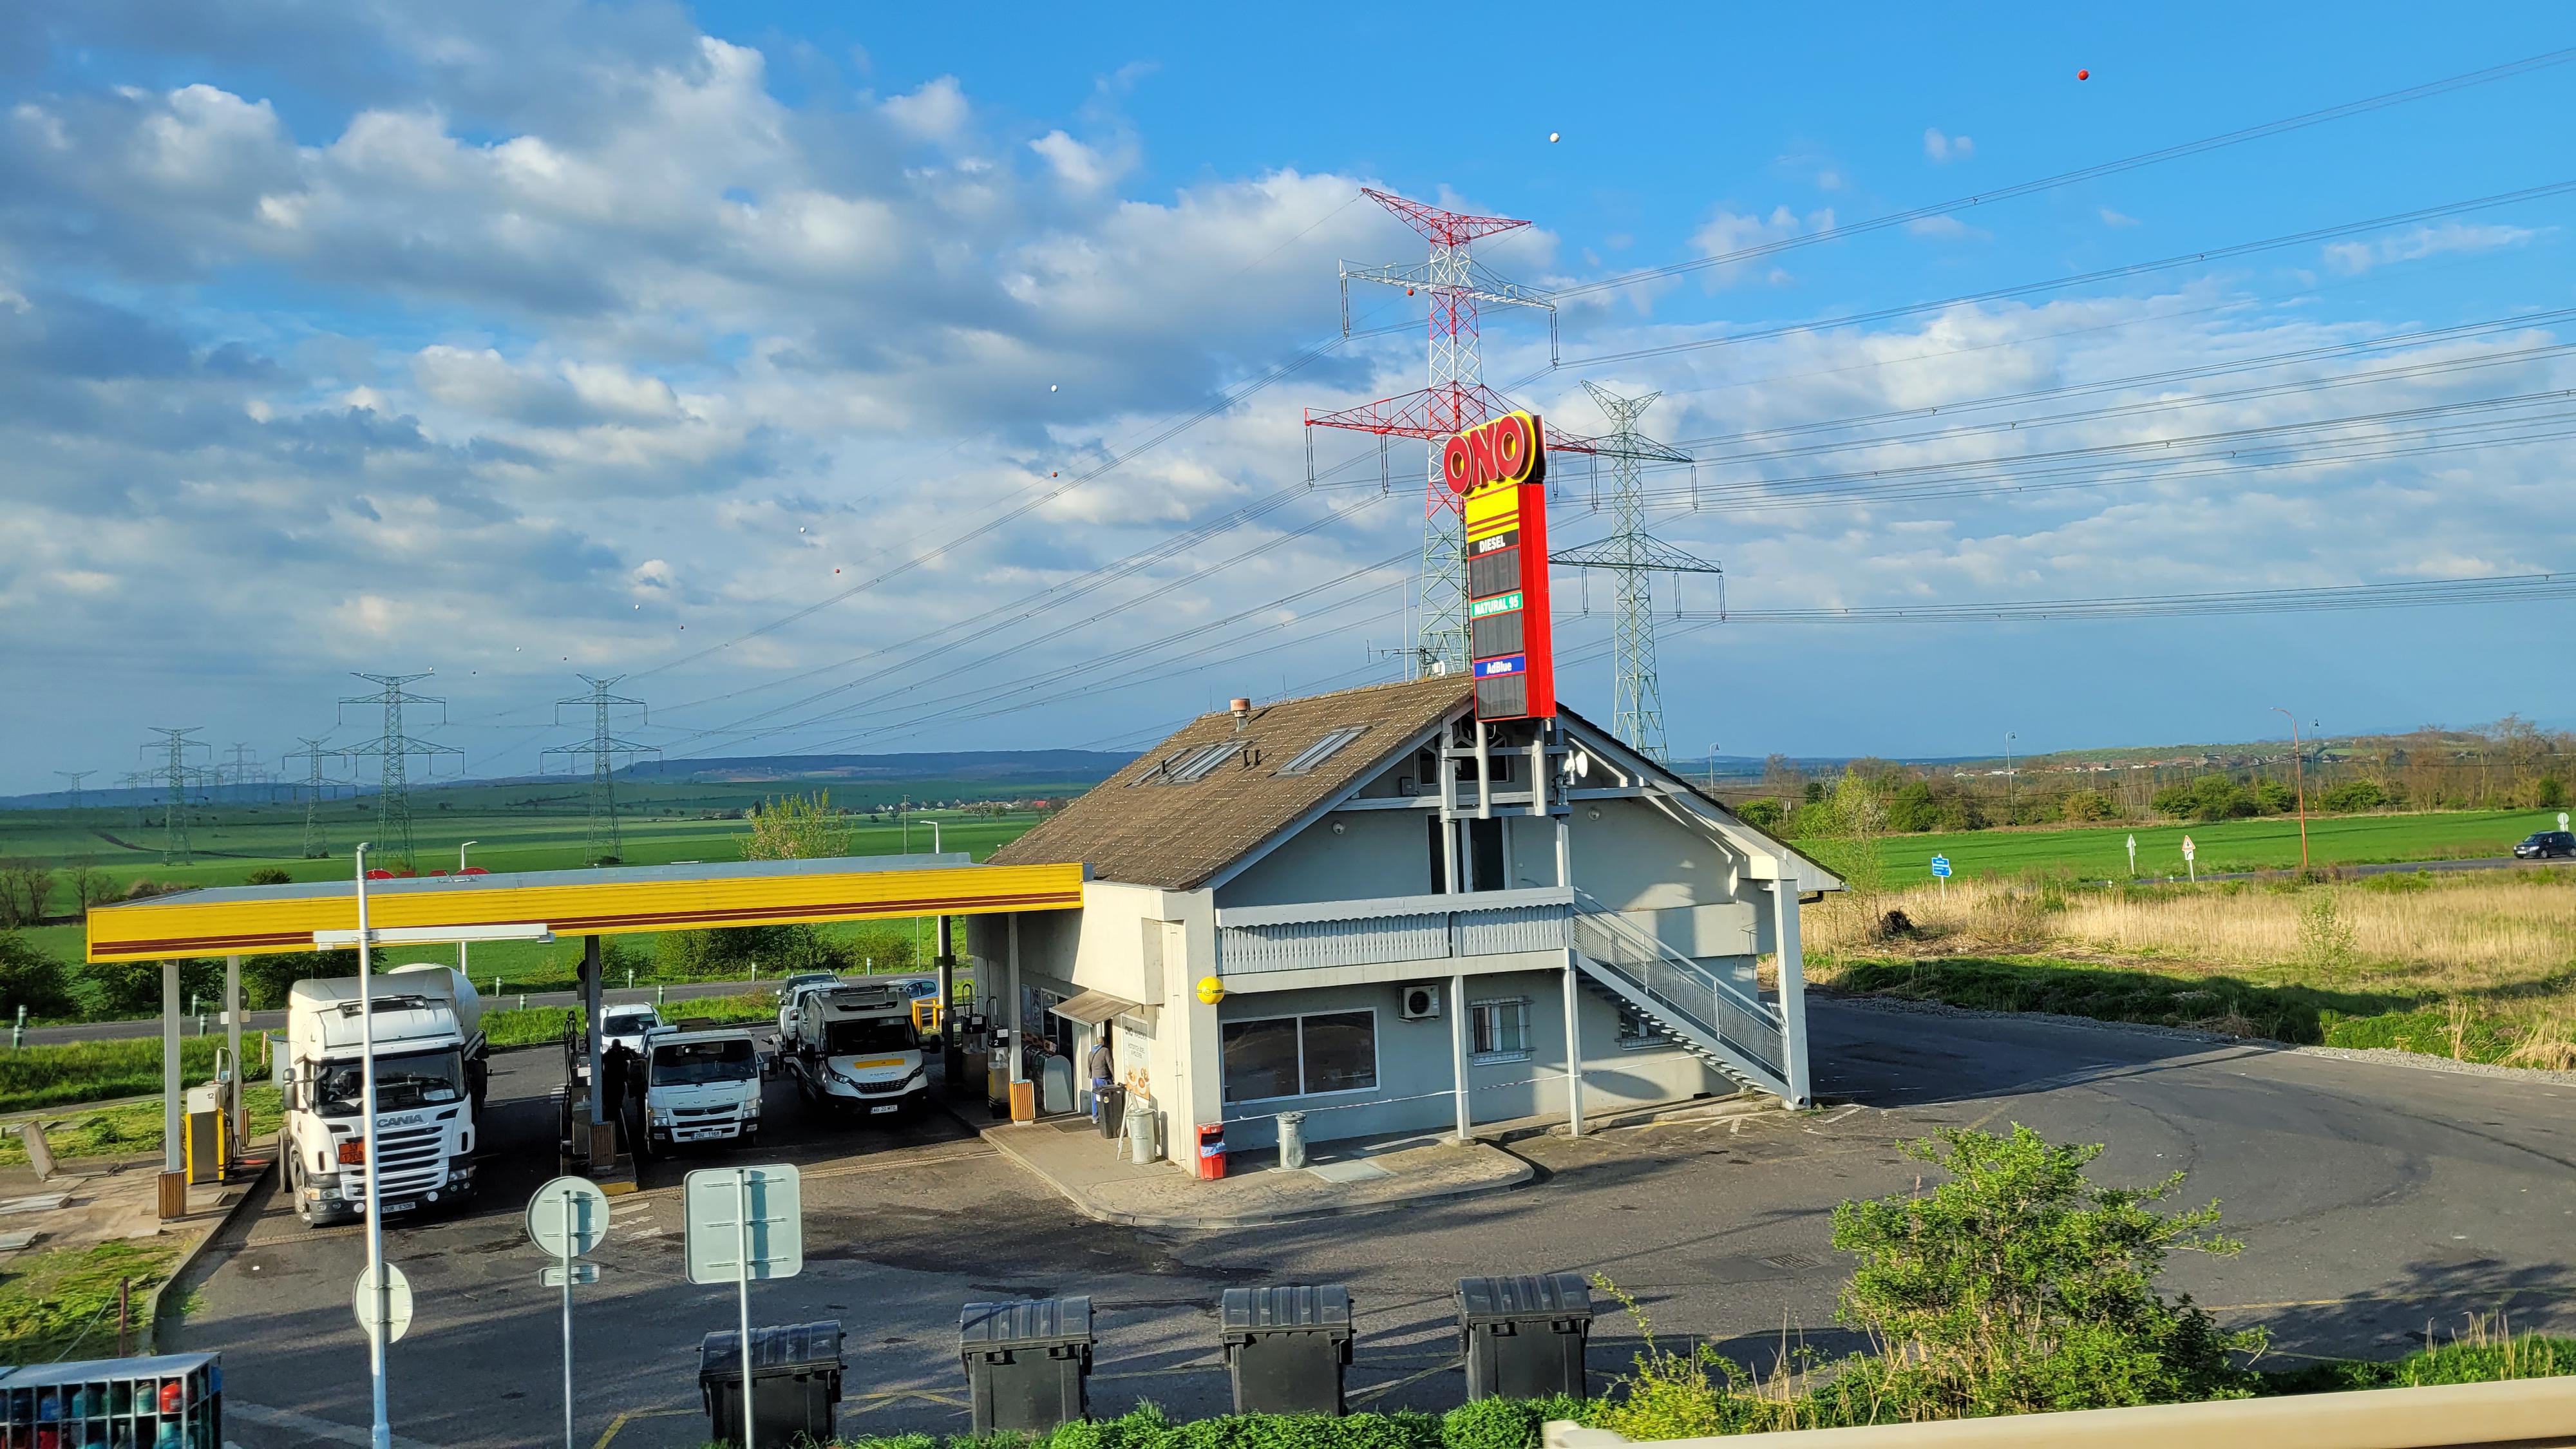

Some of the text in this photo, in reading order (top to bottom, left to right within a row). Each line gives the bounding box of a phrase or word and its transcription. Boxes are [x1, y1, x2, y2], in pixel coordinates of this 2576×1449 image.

[1443, 415, 1526, 495] ONO
[1479, 535, 1506, 553] DIESEL
[1474, 595, 1519, 616] NATURAL 95
[1486, 661, 1512, 675] AdBlue
[377, 1113, 424, 1128] CANIA
